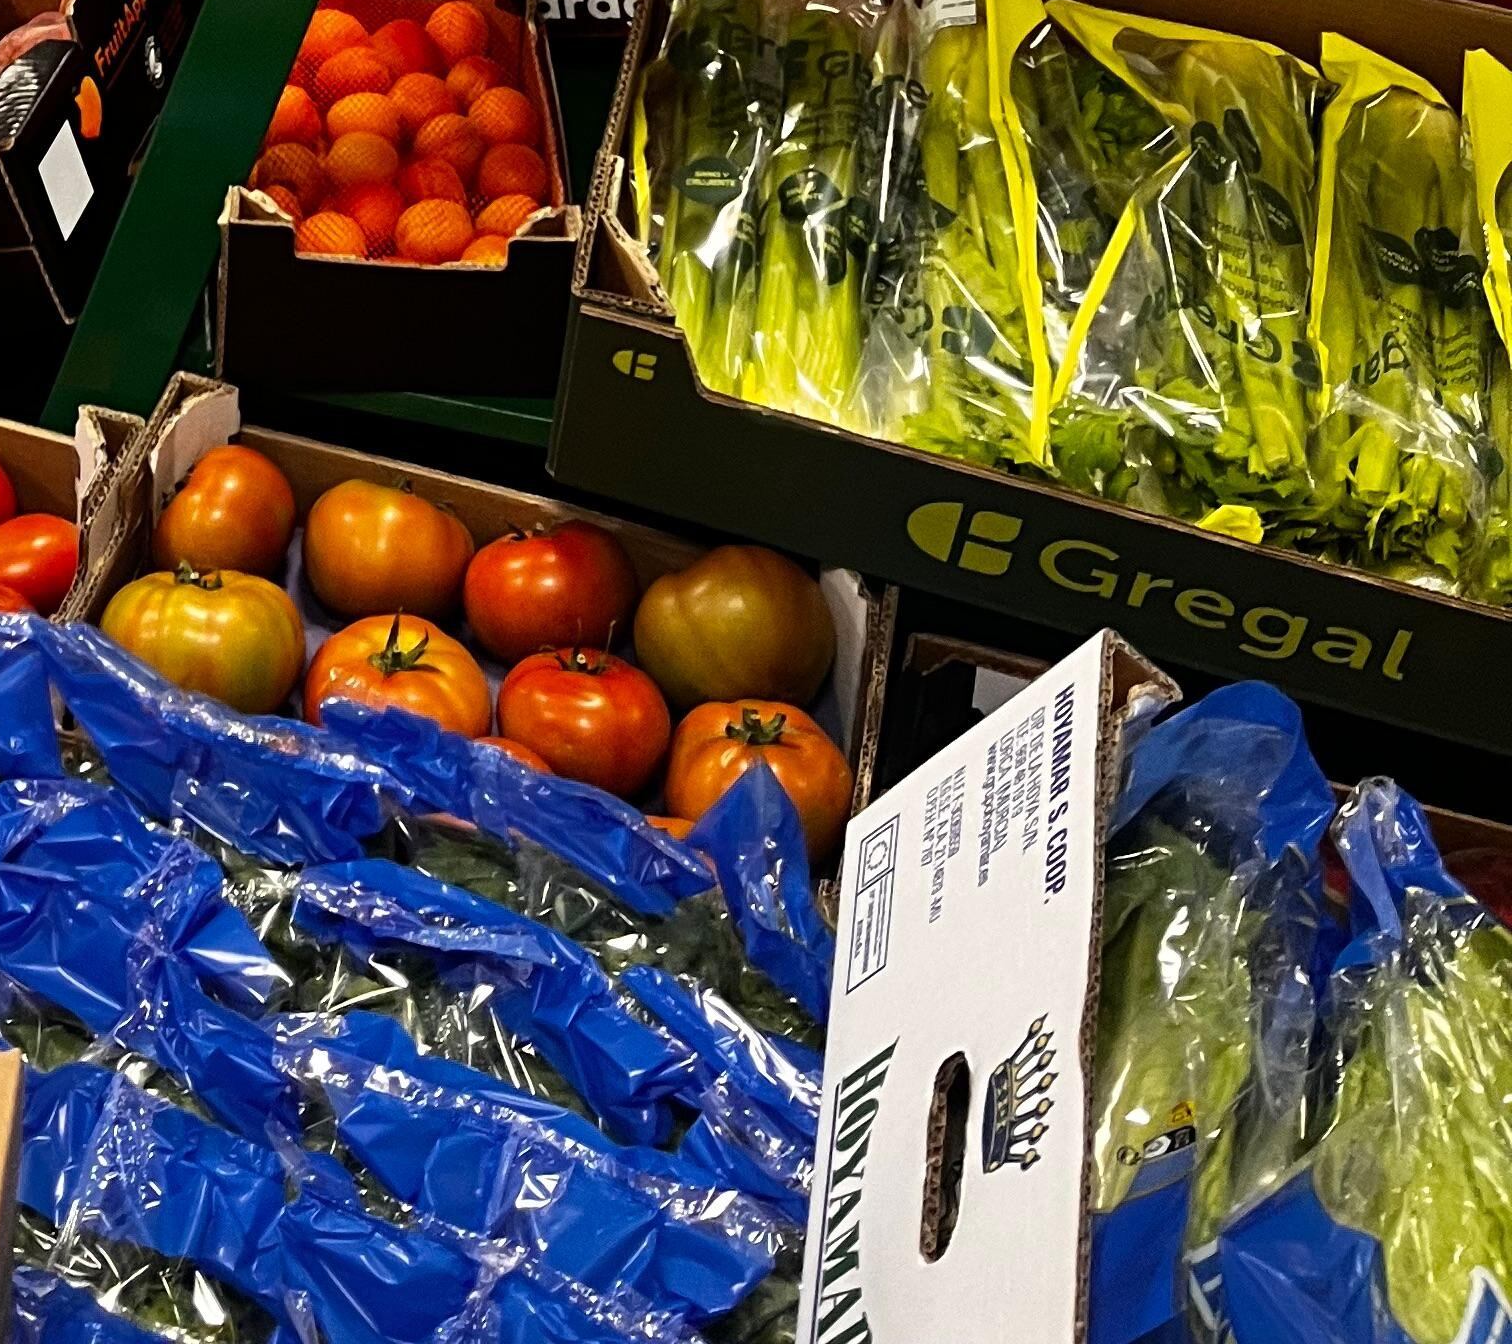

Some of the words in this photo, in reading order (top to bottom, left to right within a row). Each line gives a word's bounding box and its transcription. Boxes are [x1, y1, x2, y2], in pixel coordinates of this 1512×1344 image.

[1038, 538, 1414, 682] Gregal
[997, 727, 1016, 782] LORCA
[1049, 681, 1076, 805] HOYAMAR
[1025, 774, 1042, 821] HOYA
[1043, 827, 1069, 905] COOP.
